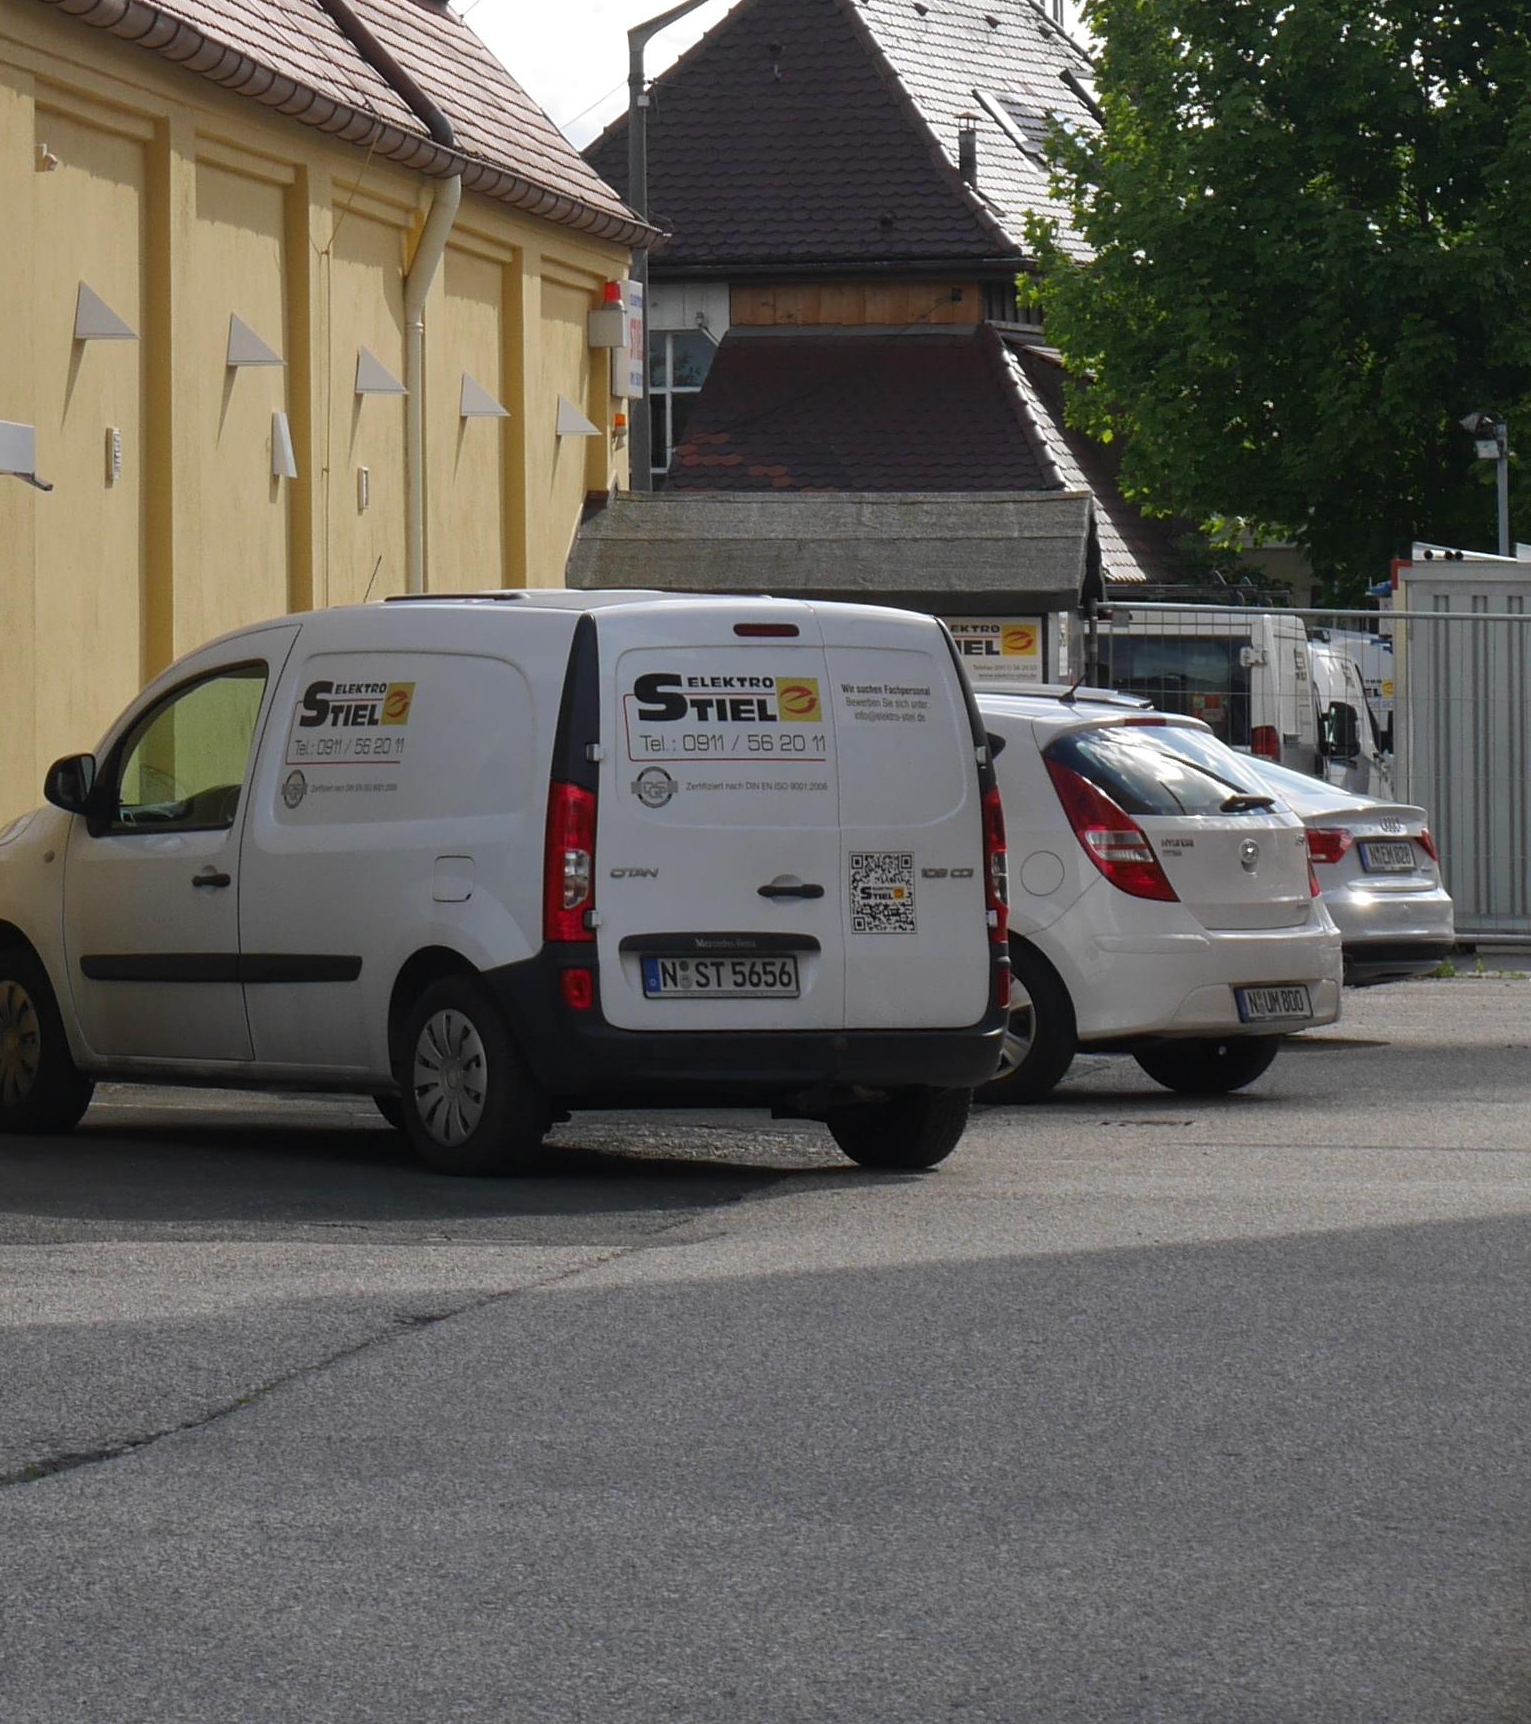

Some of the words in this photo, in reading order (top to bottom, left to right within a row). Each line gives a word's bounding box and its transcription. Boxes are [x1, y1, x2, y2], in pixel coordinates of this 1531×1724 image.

[951, 624, 1000, 633] EKTRO
[335, 683, 387, 694] ELEKTRO
[688, 677, 774, 688] ELEKTRO
[300, 681, 379, 727] STIEL
[634, 673, 777, 721] STIEL
[640, 735, 676, 751] Tel.:
[683, 734, 724, 751] 0911
[748, 734, 773, 751] 56
[780, 734, 805, 751] 20
[812, 735, 826, 751] 11
[661, 961, 678, 987] N
[695, 961, 725, 988] ST
[732, 961, 792, 988] 5656
